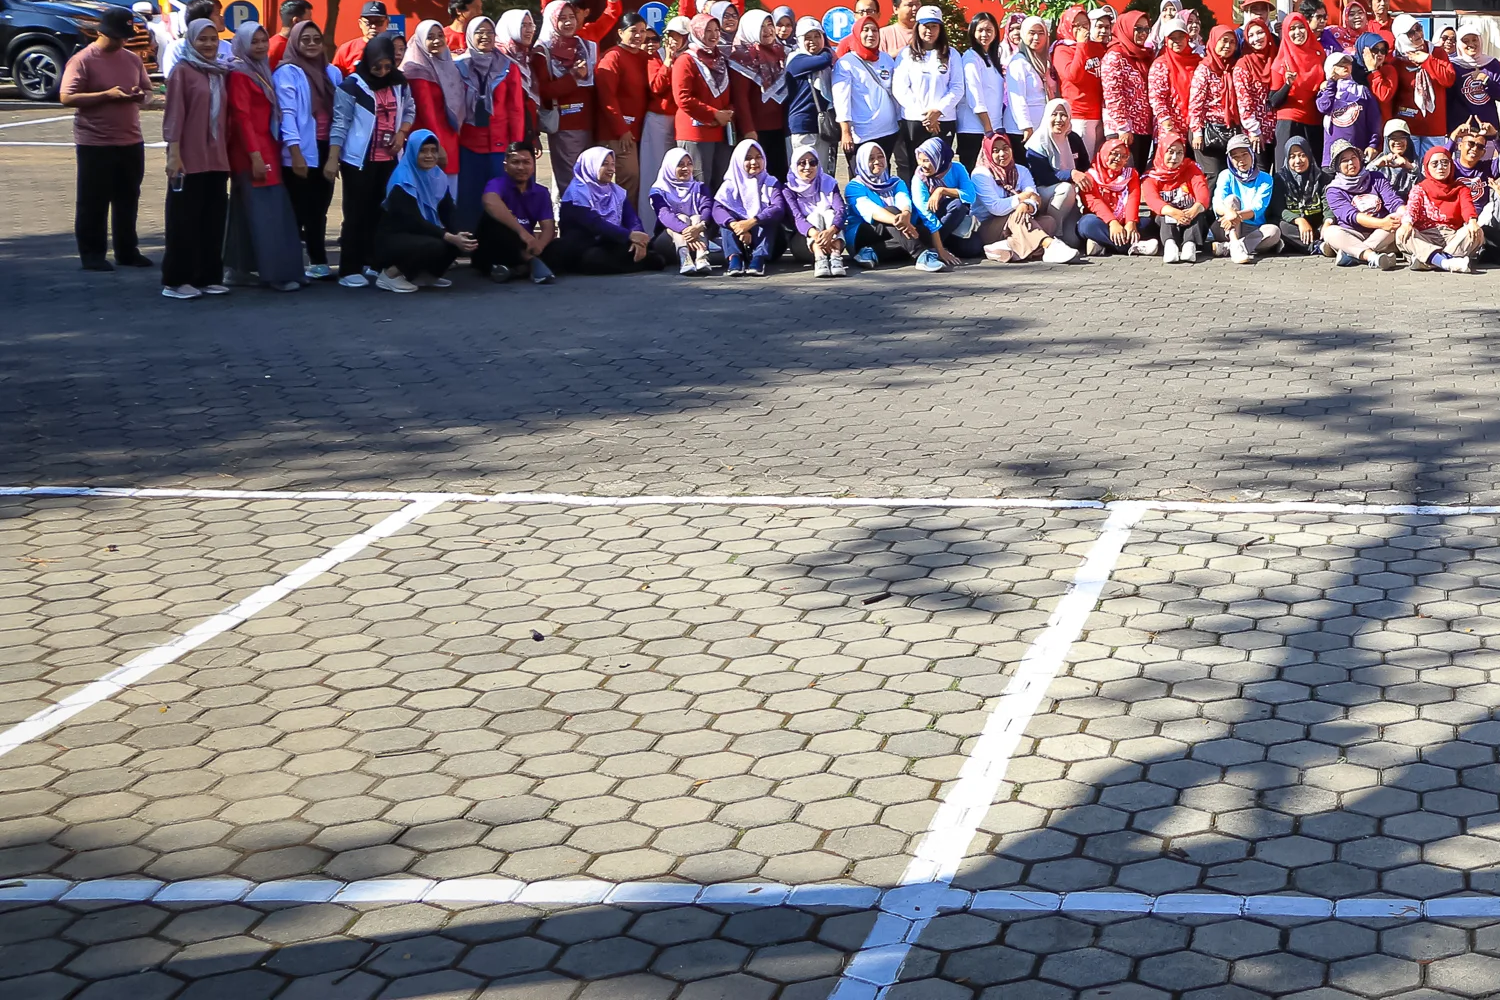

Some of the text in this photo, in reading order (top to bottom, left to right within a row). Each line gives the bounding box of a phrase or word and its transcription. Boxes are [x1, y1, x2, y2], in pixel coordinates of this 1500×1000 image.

[233, 5, 249, 29] P
[646, 7, 662, 29] P
[832, 12, 848, 38] P
